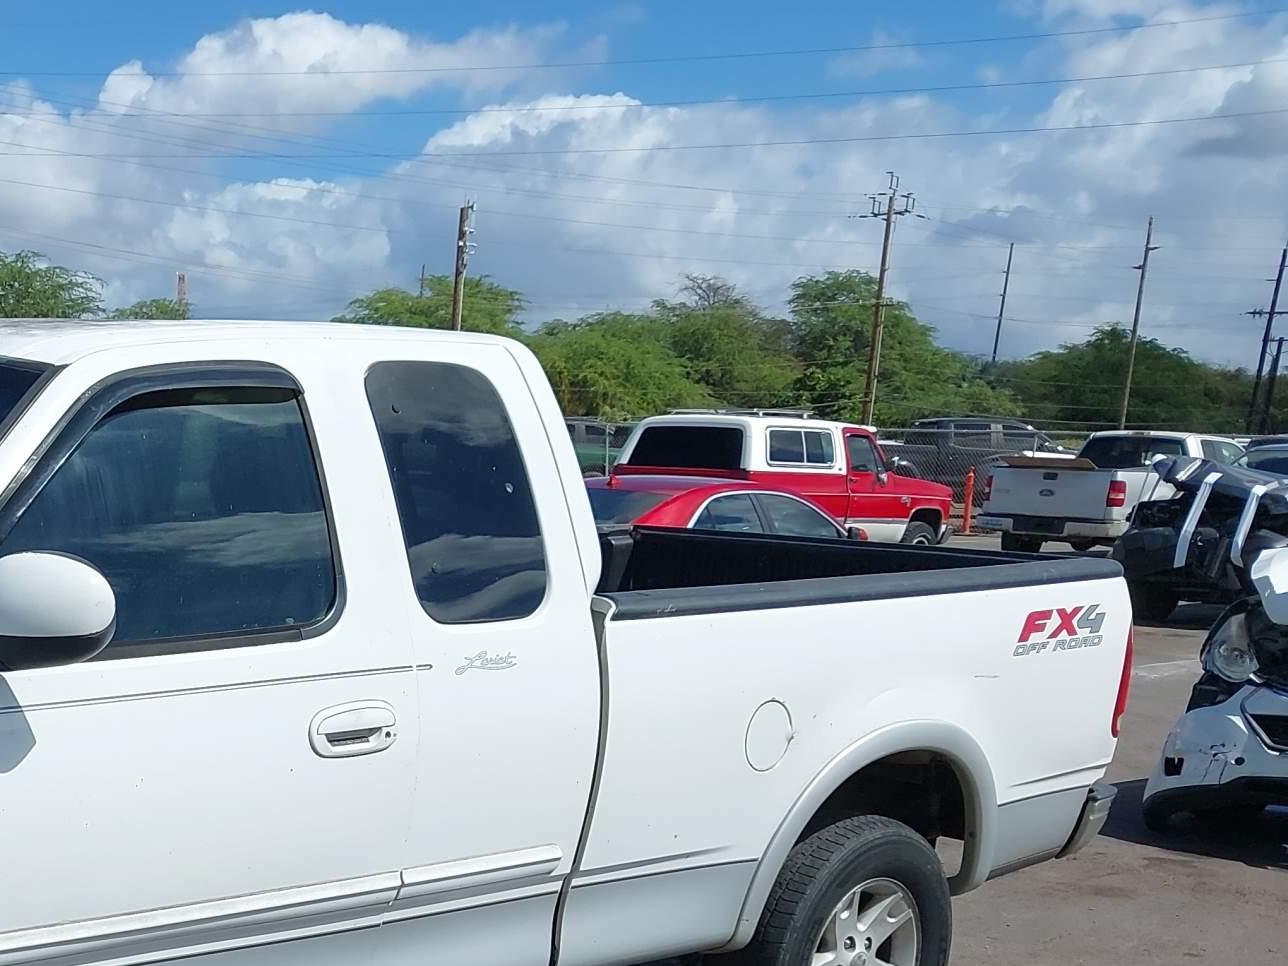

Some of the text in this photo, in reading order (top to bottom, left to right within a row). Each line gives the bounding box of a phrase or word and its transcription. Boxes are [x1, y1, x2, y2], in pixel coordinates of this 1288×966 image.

[1017, 604, 1106, 643] FX4
[1013, 635, 1104, 656] OFF ROAD
